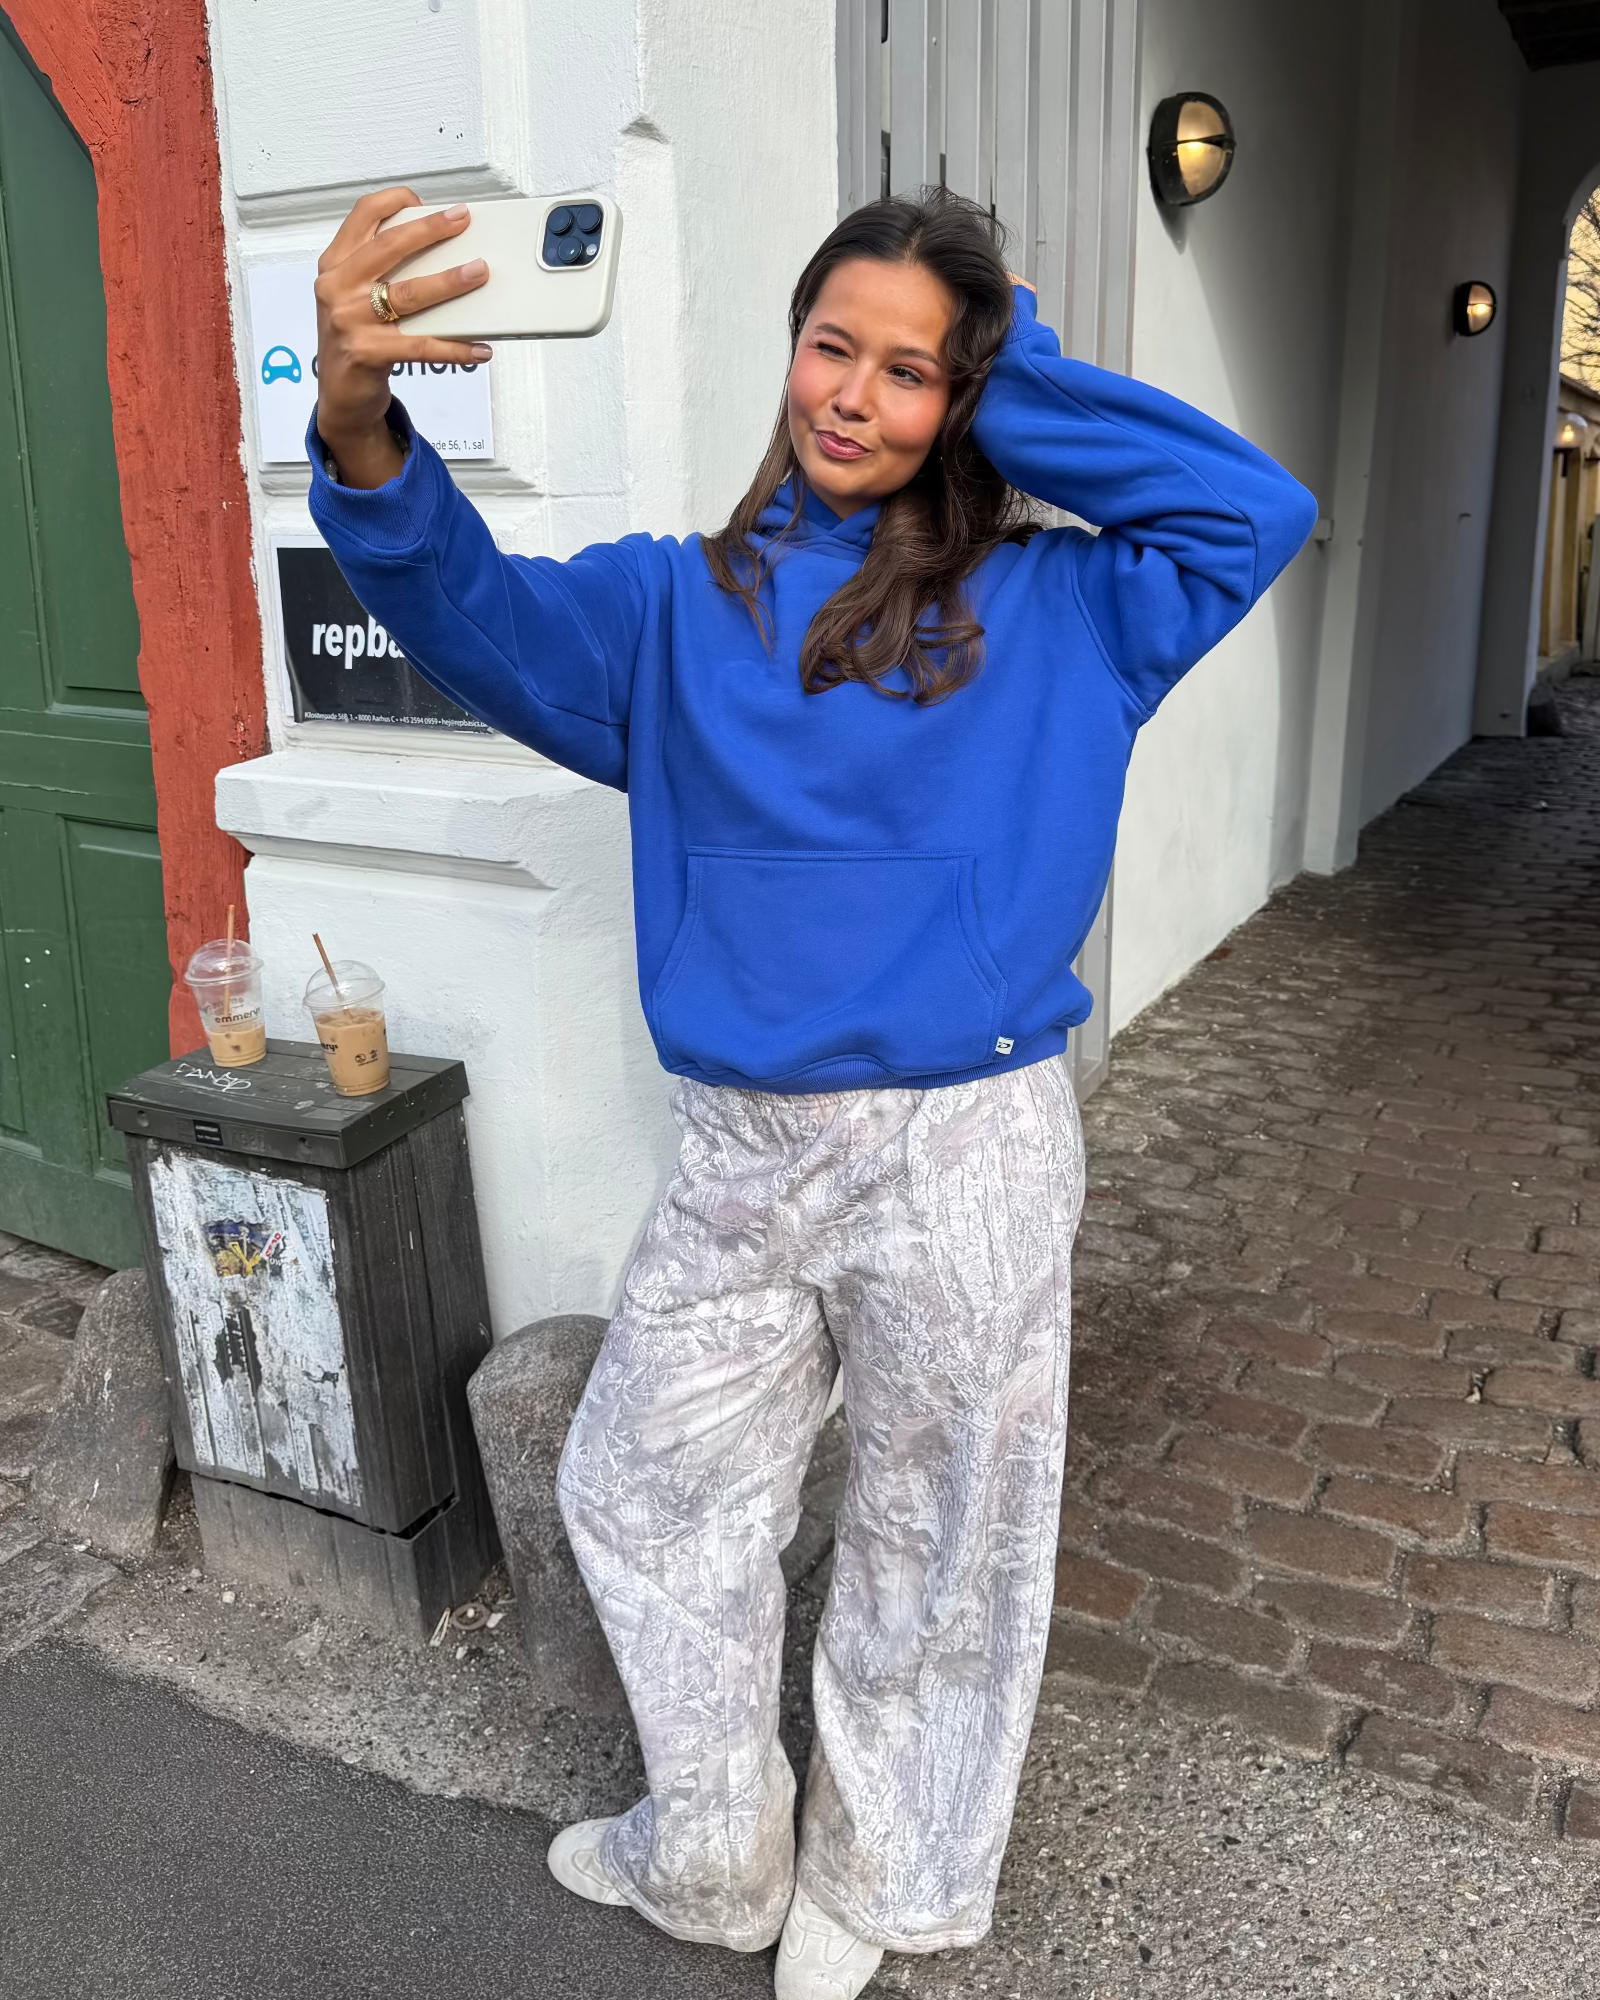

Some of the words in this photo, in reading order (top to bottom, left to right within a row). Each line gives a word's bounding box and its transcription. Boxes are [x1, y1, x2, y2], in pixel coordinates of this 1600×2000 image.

[448, 440, 461, 451] 56,
[463, 440, 471, 450] 1.
[472, 439, 485, 450] sal
[358, 714, 372, 722] 8000
[372, 715, 391, 723] Aarhus
[391, 715, 396, 723] C
[410, 716, 424, 724] 2594
[424, 717, 438, 725] 0959
